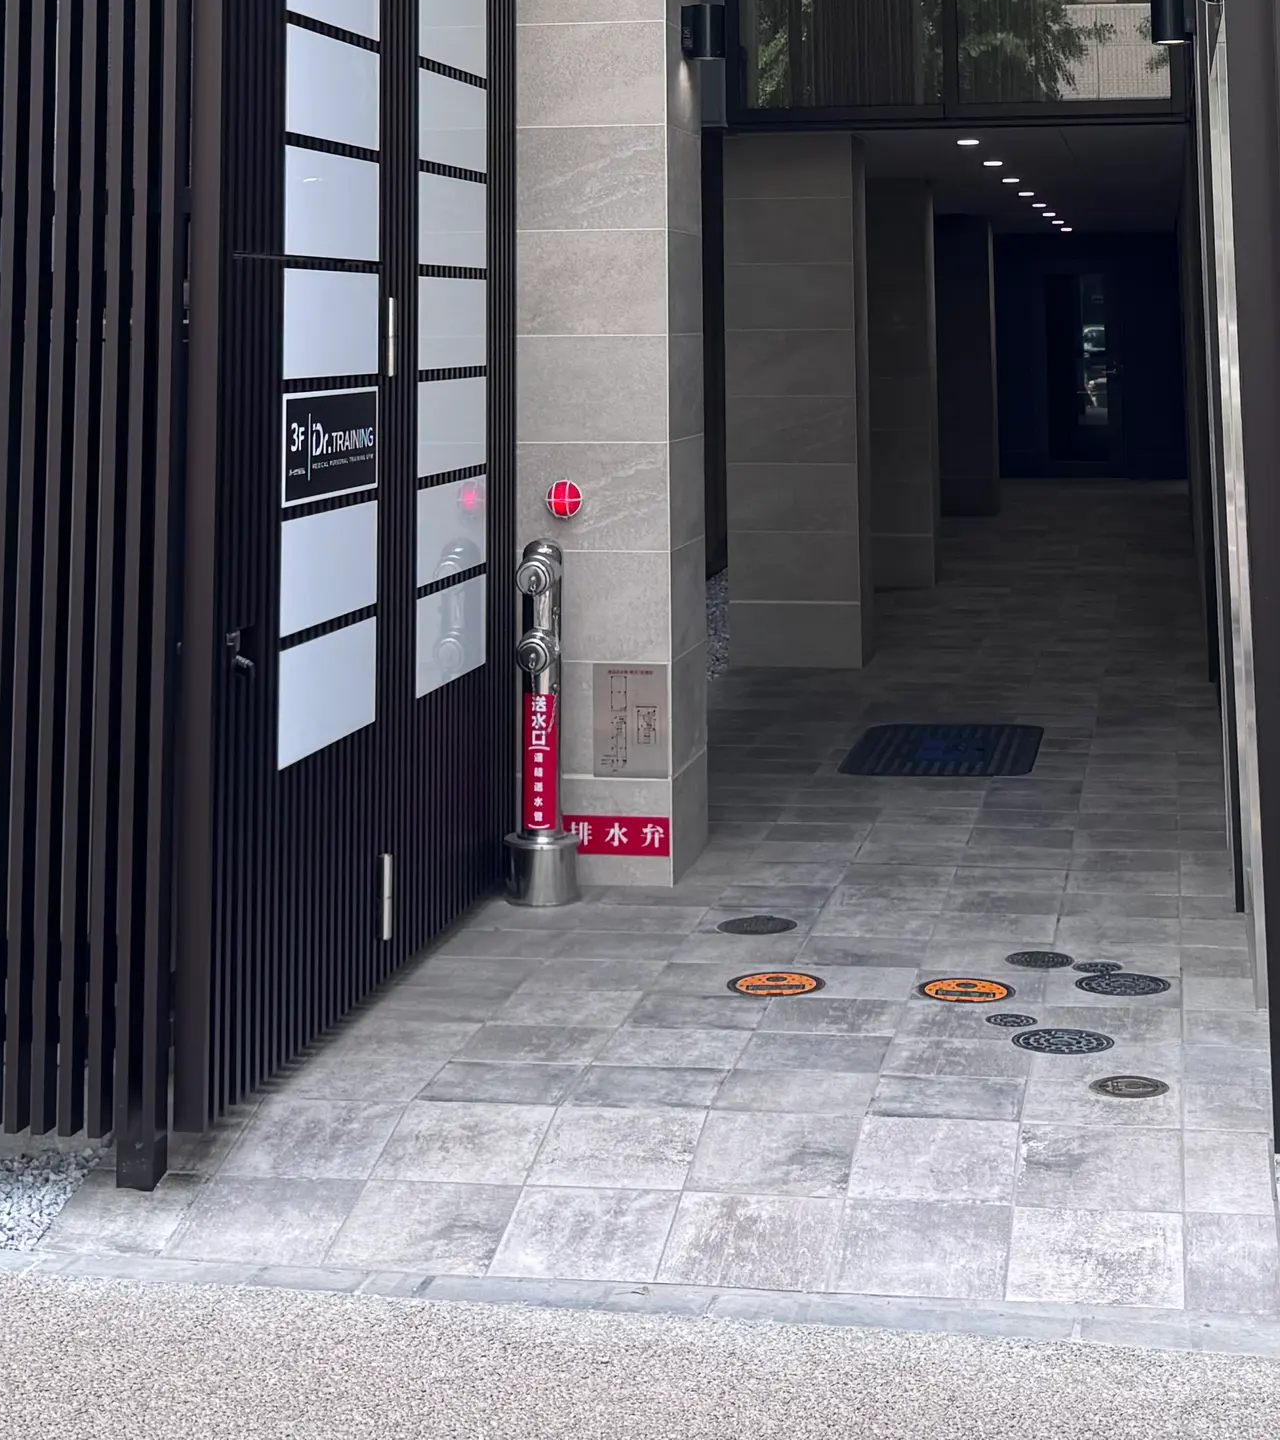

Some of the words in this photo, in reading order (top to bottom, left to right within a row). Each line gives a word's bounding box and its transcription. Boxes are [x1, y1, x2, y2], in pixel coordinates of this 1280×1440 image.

[290, 422, 305, 452] 3F
[531, 696, 547, 745] 送水口
[569, 822, 665, 848] 排水弁
